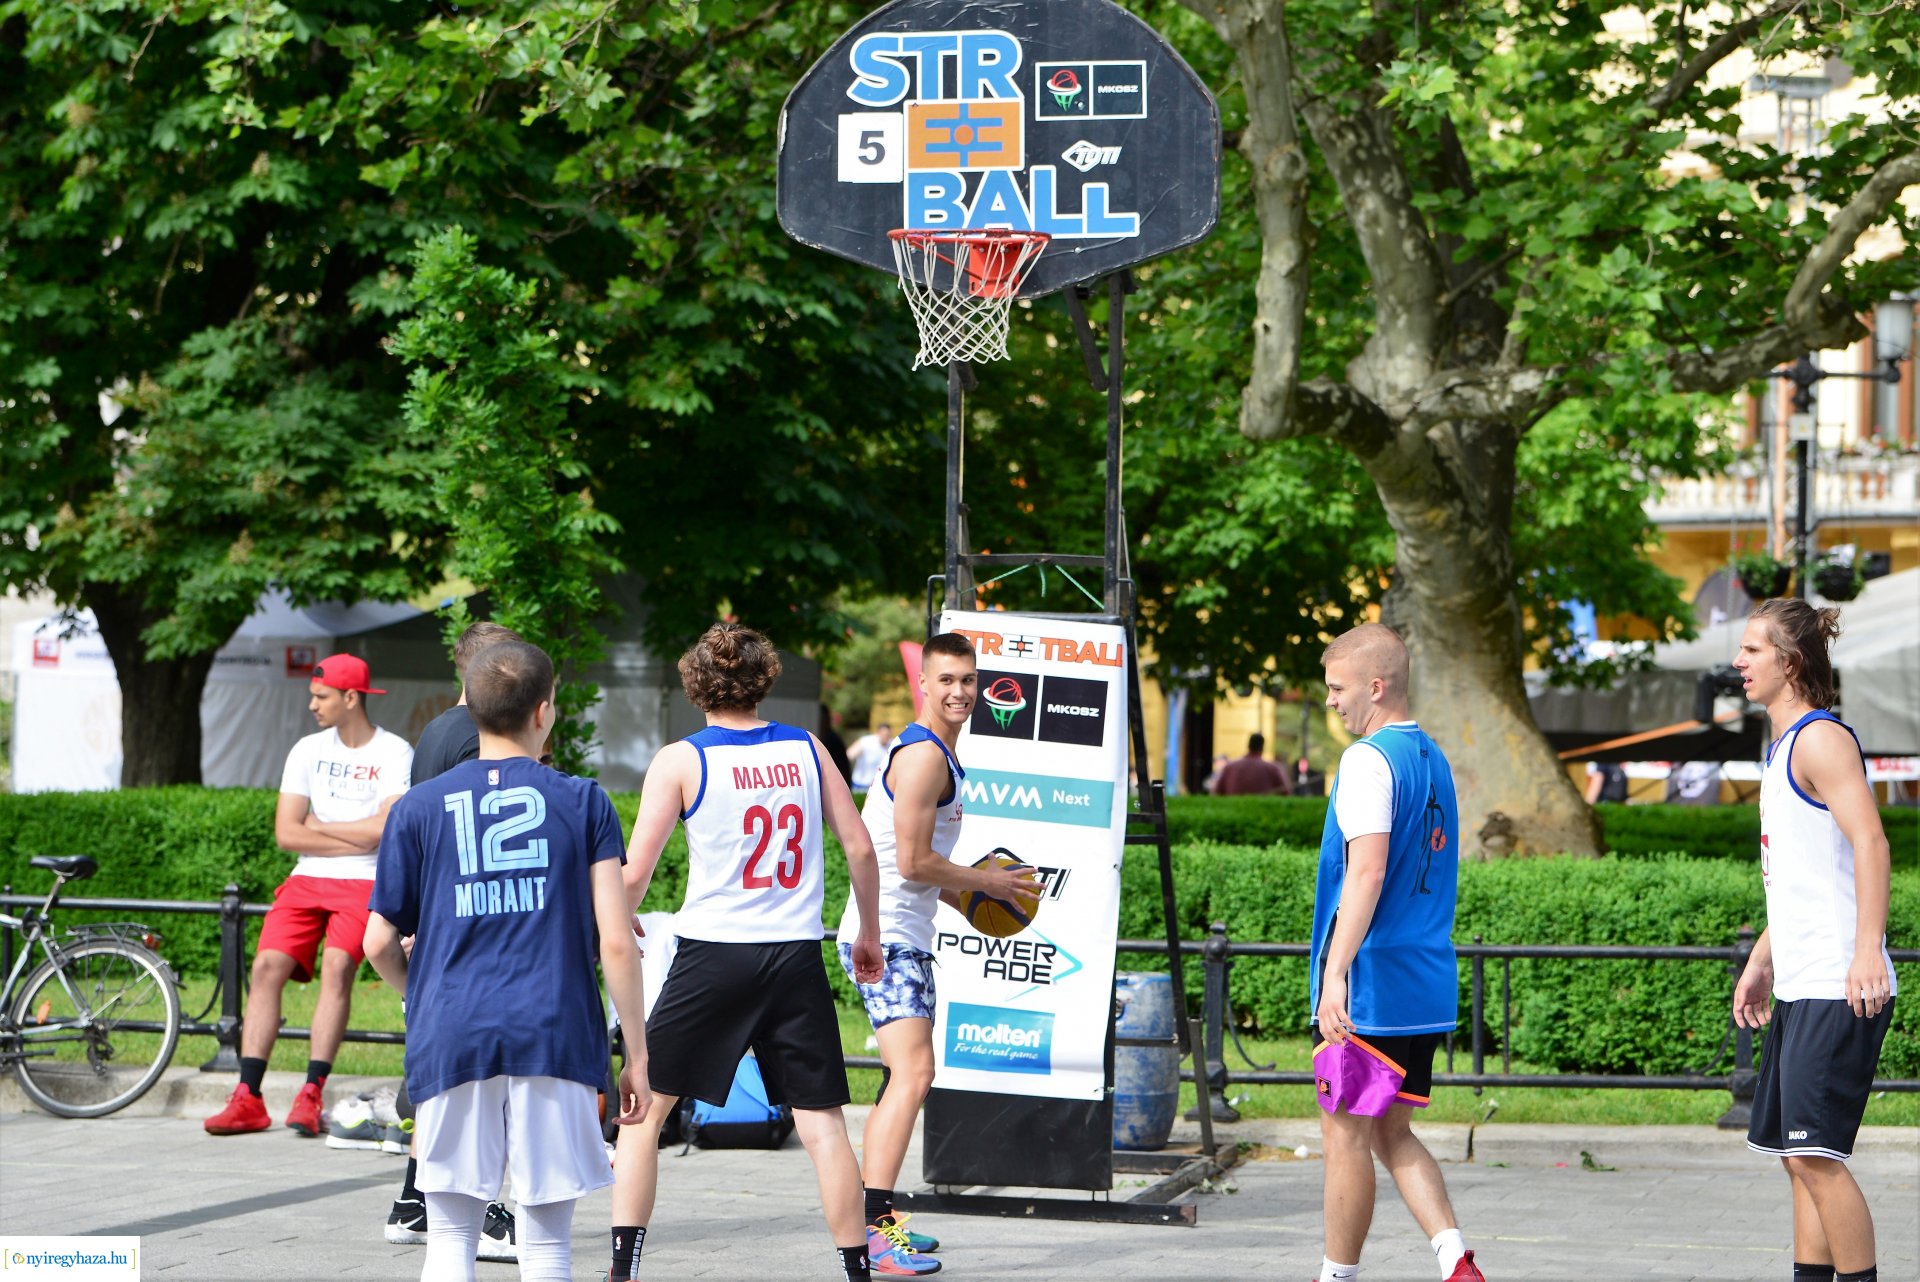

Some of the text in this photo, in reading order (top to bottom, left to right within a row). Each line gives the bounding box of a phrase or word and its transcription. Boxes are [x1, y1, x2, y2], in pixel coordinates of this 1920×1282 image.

[846, 30, 1023, 107] STR
[1097, 85, 1138, 94] MKOSZ
[858, 130, 886, 165] 5
[904, 165, 1140, 239] BALL
[1047, 703, 1100, 718] MKOSZ
[732, 763, 802, 790] MAJOR
[961, 779, 1091, 809] MVM Next
[443, 785, 549, 876] 12
[742, 803, 804, 890] 23
[455, 876, 547, 918] MORANT
[937, 932, 1058, 964] POWER
[983, 959, 1052, 985] ADE
[953, 1042, 1039, 1061] For the real game
[957, 1023, 1041, 1049] molten
